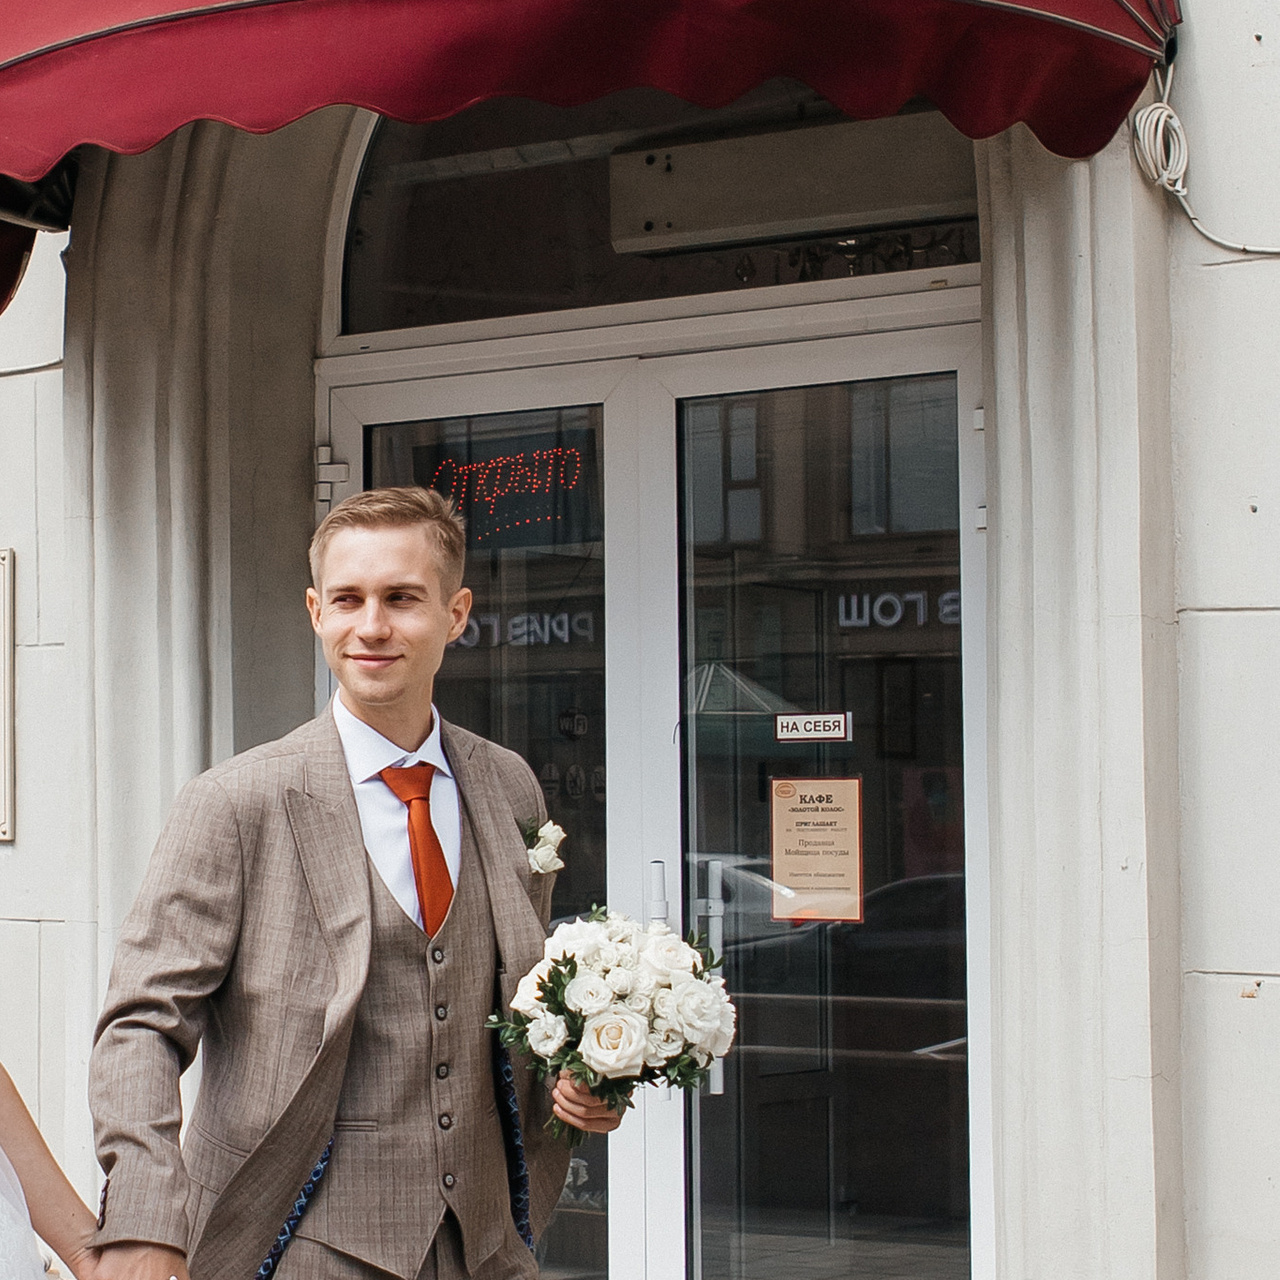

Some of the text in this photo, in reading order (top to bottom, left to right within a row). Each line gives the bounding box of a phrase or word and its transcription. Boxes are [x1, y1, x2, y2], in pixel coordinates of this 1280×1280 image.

[780, 720, 841, 733] НА СЕБЯ
[799, 794, 833, 804] КАФЕ
